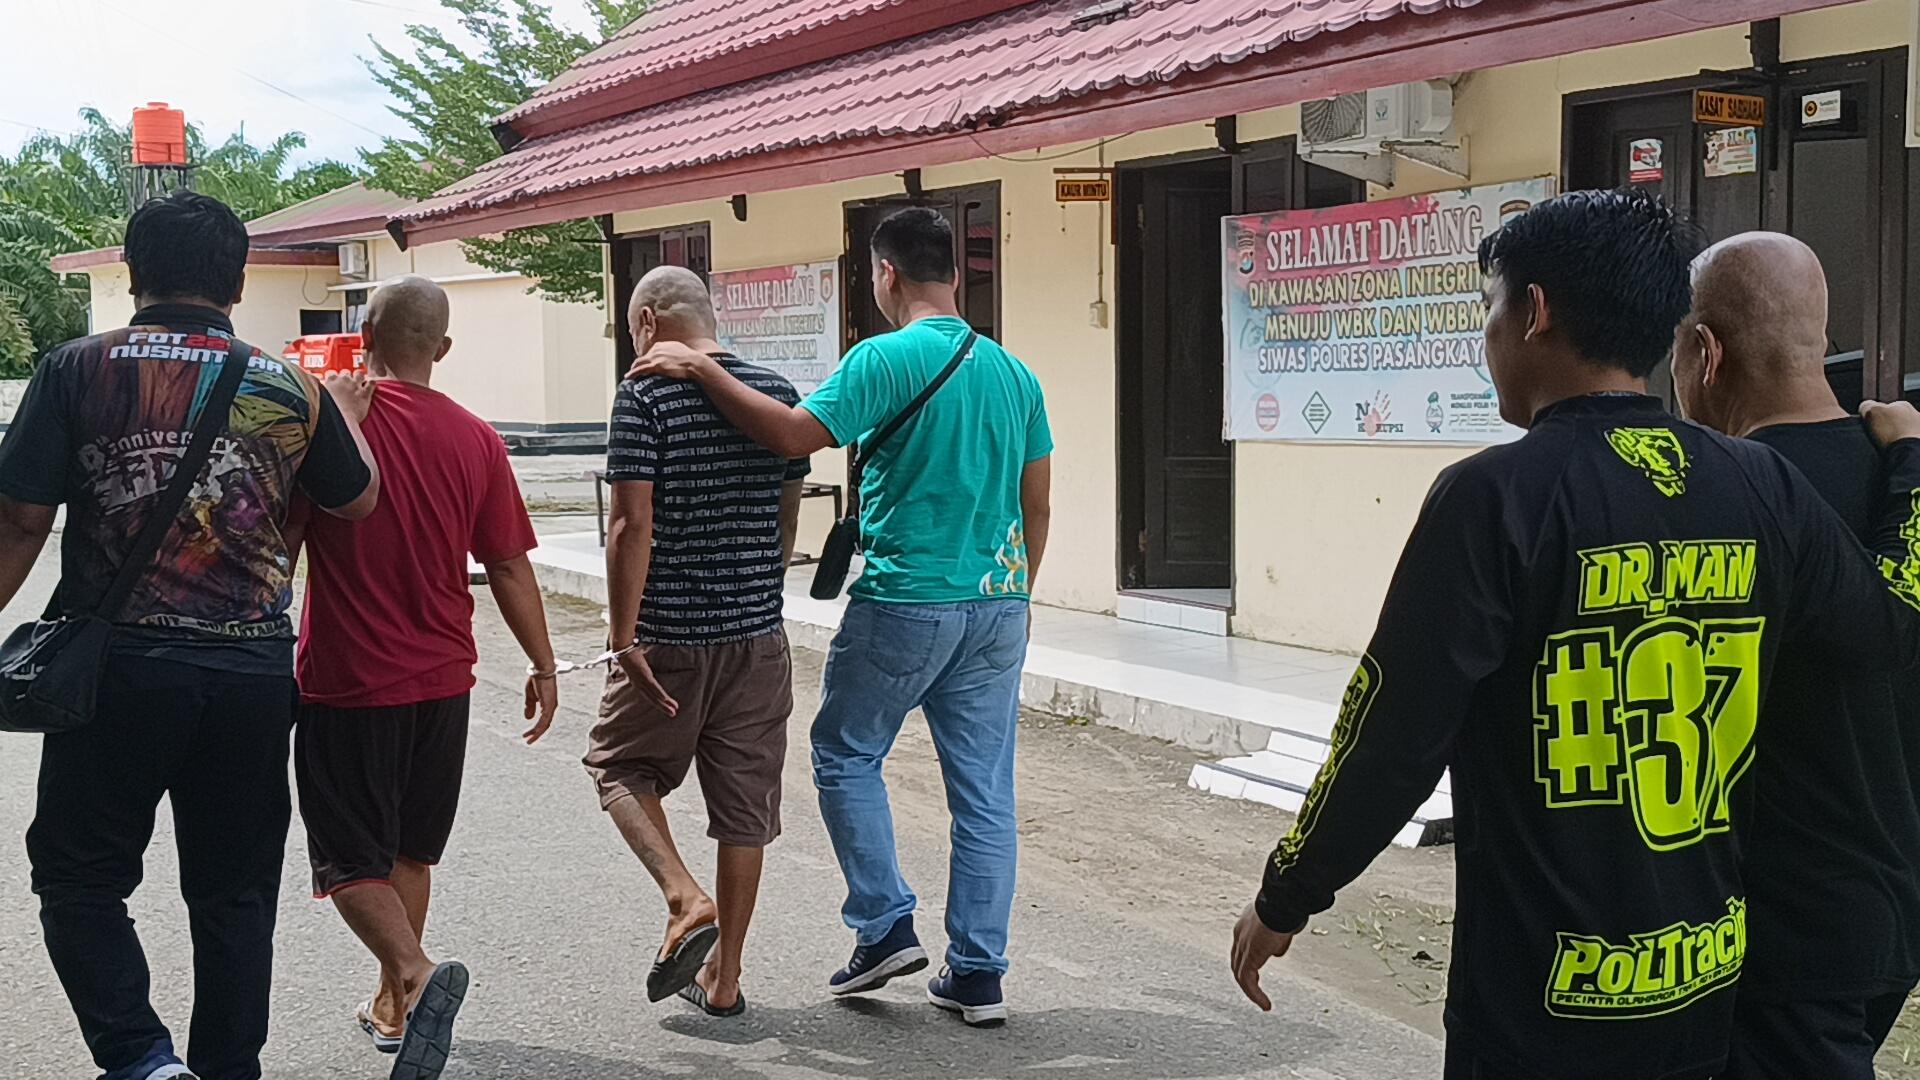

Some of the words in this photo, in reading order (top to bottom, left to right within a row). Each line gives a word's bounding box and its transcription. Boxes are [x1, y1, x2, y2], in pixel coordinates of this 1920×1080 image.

[1697, 95, 1725, 117] KASAT
[1266, 220, 1372, 271] SELAMAT
[1378, 207, 1484, 262] DATANG
[726, 281, 770, 311] SELAMAT
[1250, 281, 1268, 308] DI
[1267, 273, 1350, 307] KAWASAN
[1350, 268, 1402, 301] ZONA
[1405, 262, 1482, 297] INTEGRIT
[1264, 310, 1331, 342] MENUJU
[1332, 307, 1376, 339] WBK
[1379, 304, 1422, 336] DAN
[1423, 300, 1488, 334] WBBM
[109, 345, 283, 374] NUSANTRA
[1257, 346, 1308, 373] SIWAS
[1309, 342, 1371, 371] POLRES
[1372, 336, 1487, 369] PASANGKAY
[1538, 620, 1765, 848] #37
[1556, 993, 1614, 1005] PECINTA
[1616, 987, 1677, 1006] OLAHRAGA
